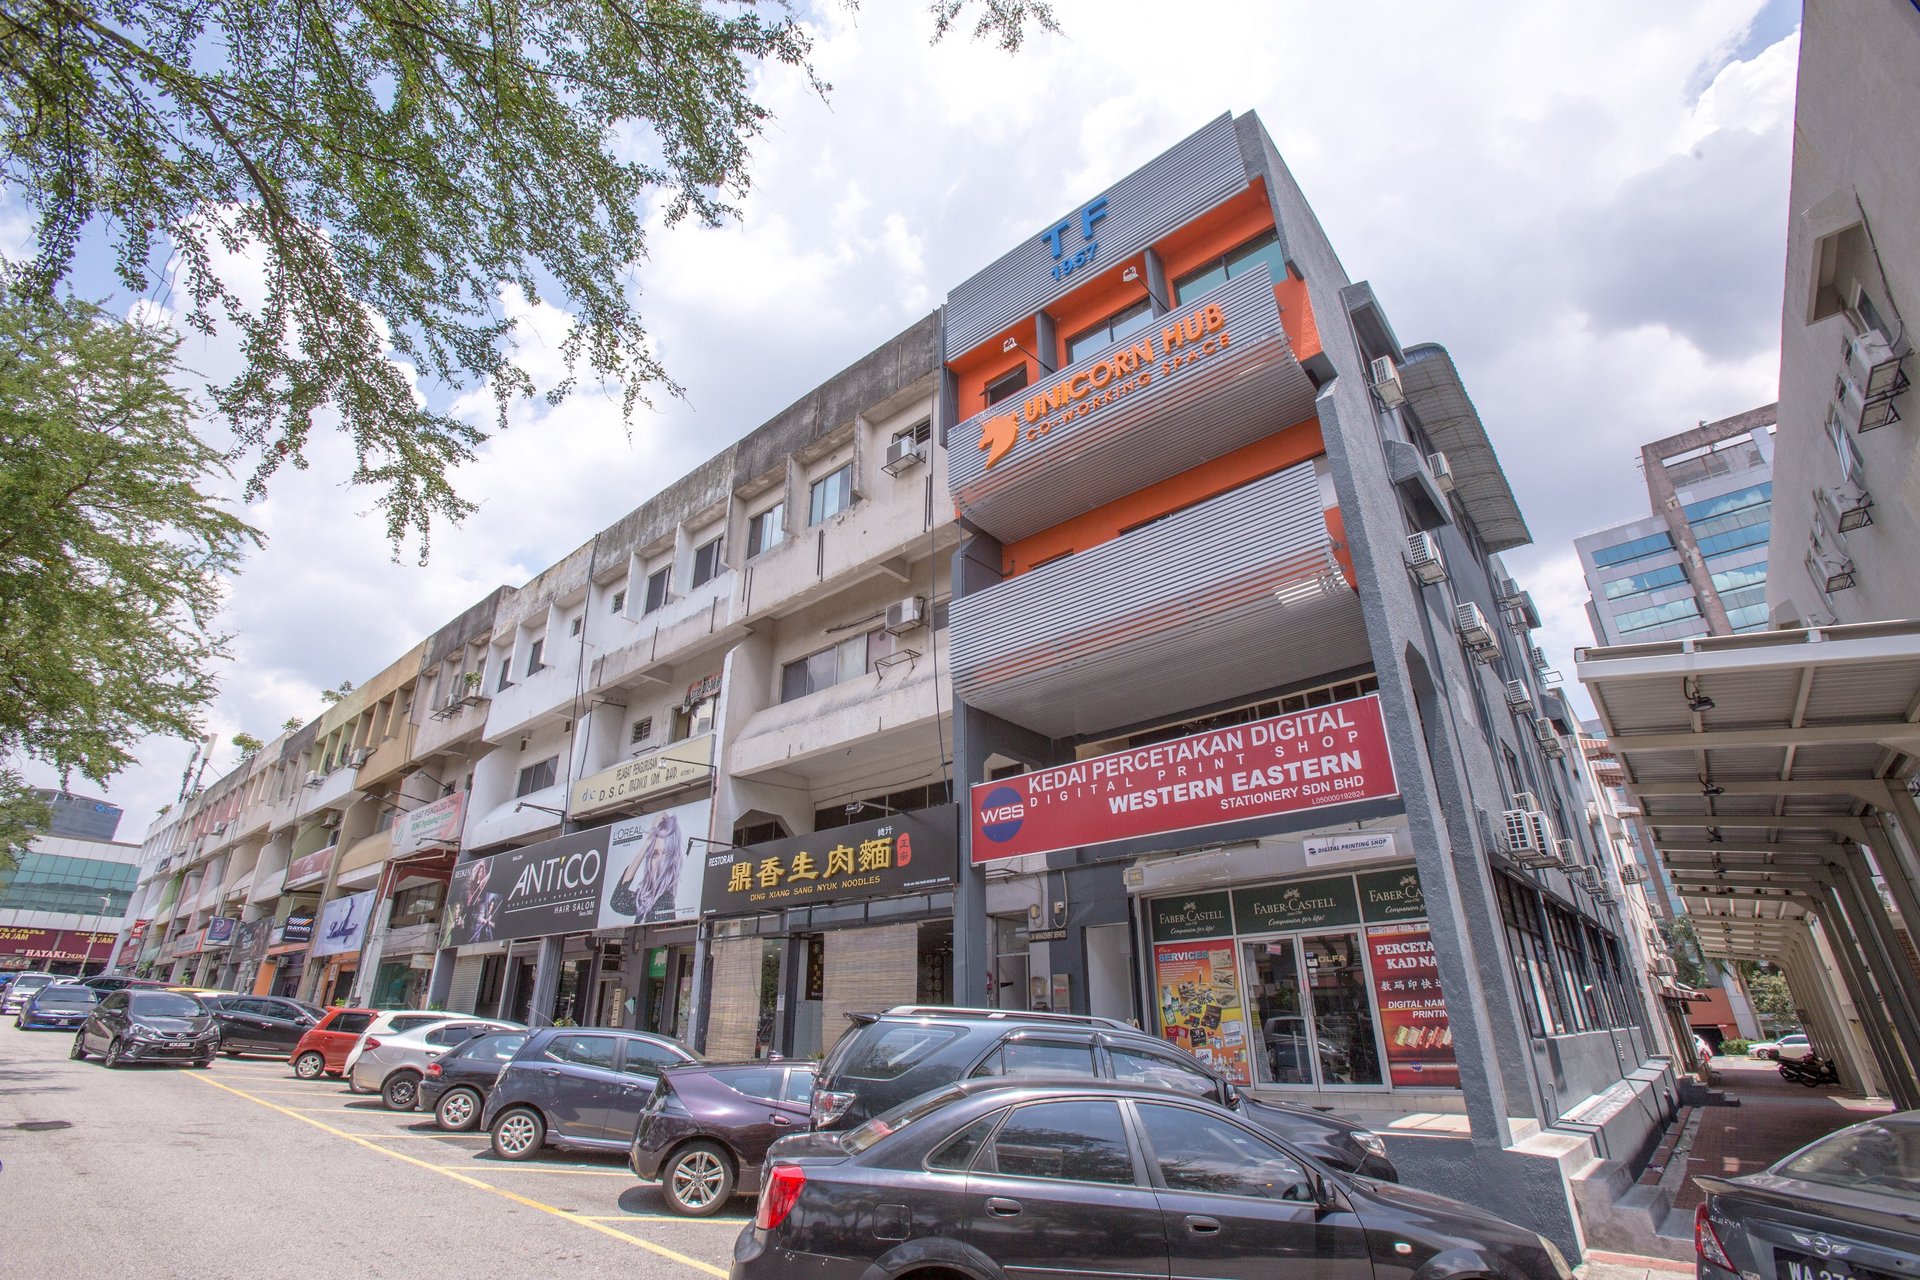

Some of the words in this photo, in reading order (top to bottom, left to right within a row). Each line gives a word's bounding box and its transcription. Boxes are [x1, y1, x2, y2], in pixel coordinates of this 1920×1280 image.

[1050, 239, 1098, 281] 1957
[1024, 339, 1154, 424] UNICORN
[1161, 303, 1225, 355] HUB
[1026, 372, 1151, 441] CO-WORKING
[1162, 331, 1231, 376] SPACE
[1028, 765, 1087, 795] KEDAI
[1092, 730, 1244, 781] PERCETAKAN
[1250, 708, 1355, 747] DIGITAL
[1030, 777, 1133, 808] DIGITAL
[1158, 753, 1245, 781] PRINT
[1275, 730, 1358, 758] SHOP
[1108, 776, 1224, 815] WESTERN
[1231, 750, 1363, 793] EASTERN
[1220, 786, 1299, 810] STATIONERY
[1302, 781, 1331, 797] SDN
[1334, 775, 1364, 791] BHD
[981, 803, 1025, 825] wes
[1318, 846, 1341, 854] DIGITAL
[1341, 841, 1370, 850] PRINTING
[1370, 838, 1388, 846] SHOP
[708, 853, 734, 868] RESTORAN
[727, 838, 893, 893] 鼎香生肉麵
[750, 893, 766, 902] DING
[768, 889, 790, 900] XIANG
[793, 885, 813, 896] SANG
[816, 882, 838, 893] NYUK
[841, 875, 881, 888] NOODLES
[554, 904, 570, 915] HAIR
[572, 900, 595, 912] SALON
[1253, 897, 1337, 916] FABER-CASTELL
[25, 949, 67, 959] HAYAKI
[1158, 950, 1210, 962] SERVICES
[1318, 954, 1347, 963] OLFA
[1386, 957, 1416, 970] KAD
[1388, 1000, 1422, 1010] DIGITAL
